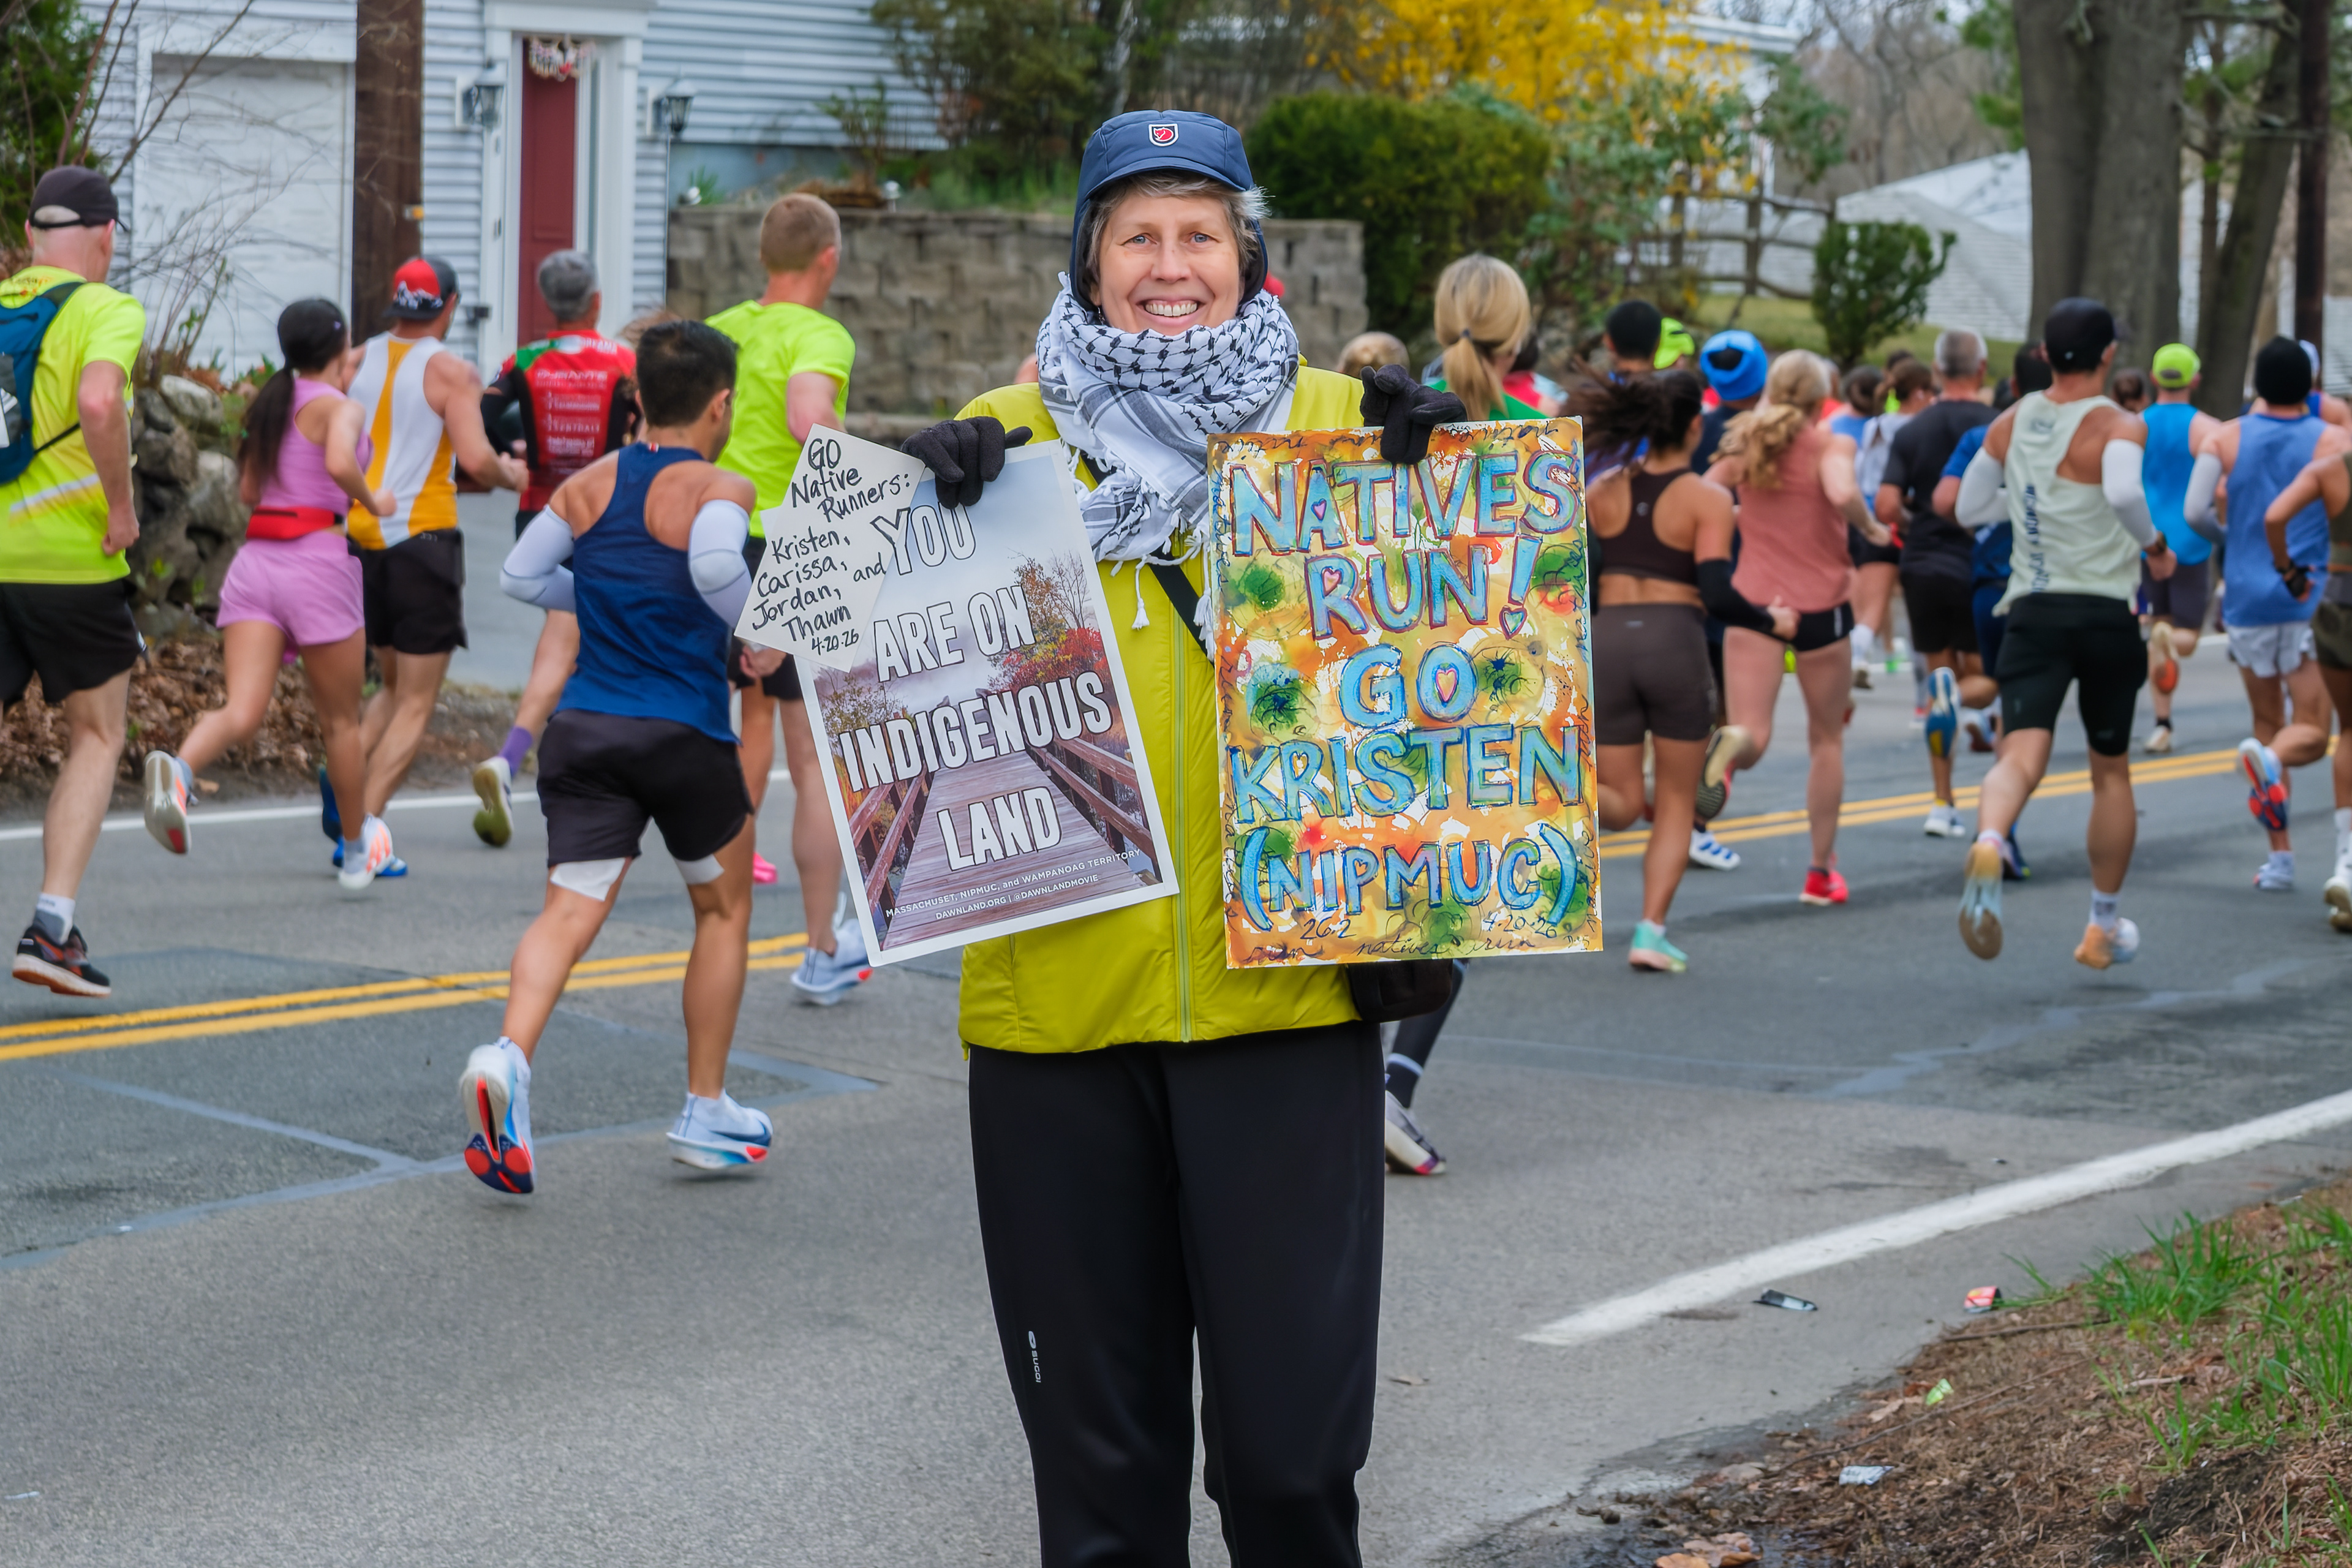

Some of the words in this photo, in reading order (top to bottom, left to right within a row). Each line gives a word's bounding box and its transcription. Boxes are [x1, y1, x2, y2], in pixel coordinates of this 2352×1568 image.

[791, 468, 862, 508] Native
[808, 438, 842, 470] GO
[817, 473, 910, 522] Runners:
[1230, 450, 1580, 557] NATIVES
[757, 556, 848, 598] Carissa,
[771, 526, 851, 564] Kristen,
[870, 502, 976, 576] YOU
[752, 584, 842, 630] Jordan,
[853, 552, 886, 582] and
[1305, 534, 1544, 641] RUN!
[873, 601, 965, 683] ARE
[968, 585, 1036, 657] ON
[1340, 643, 1477, 729] GO
[838, 671, 1114, 793] INDIGENOUS
[1227, 724, 1584, 823] KRISTEN
[936, 786, 1063, 872] LAND
[885, 893, 958, 918] MASSACHUSET,
[960, 883, 1000, 899] NIPMUC,
[1003, 877, 1020, 889] and
[1021, 861, 1085, 884] WAMPANOAG
[1087, 848, 1141, 867] TERRITORY
[935, 896, 1006, 920] DAWNLAND.ORG
[1013, 874, 1099, 901] @DAWNLANDMOVIE
[1240, 823, 1578, 931] (NIPMUC)
[1299, 918, 1357, 940] 26.2
